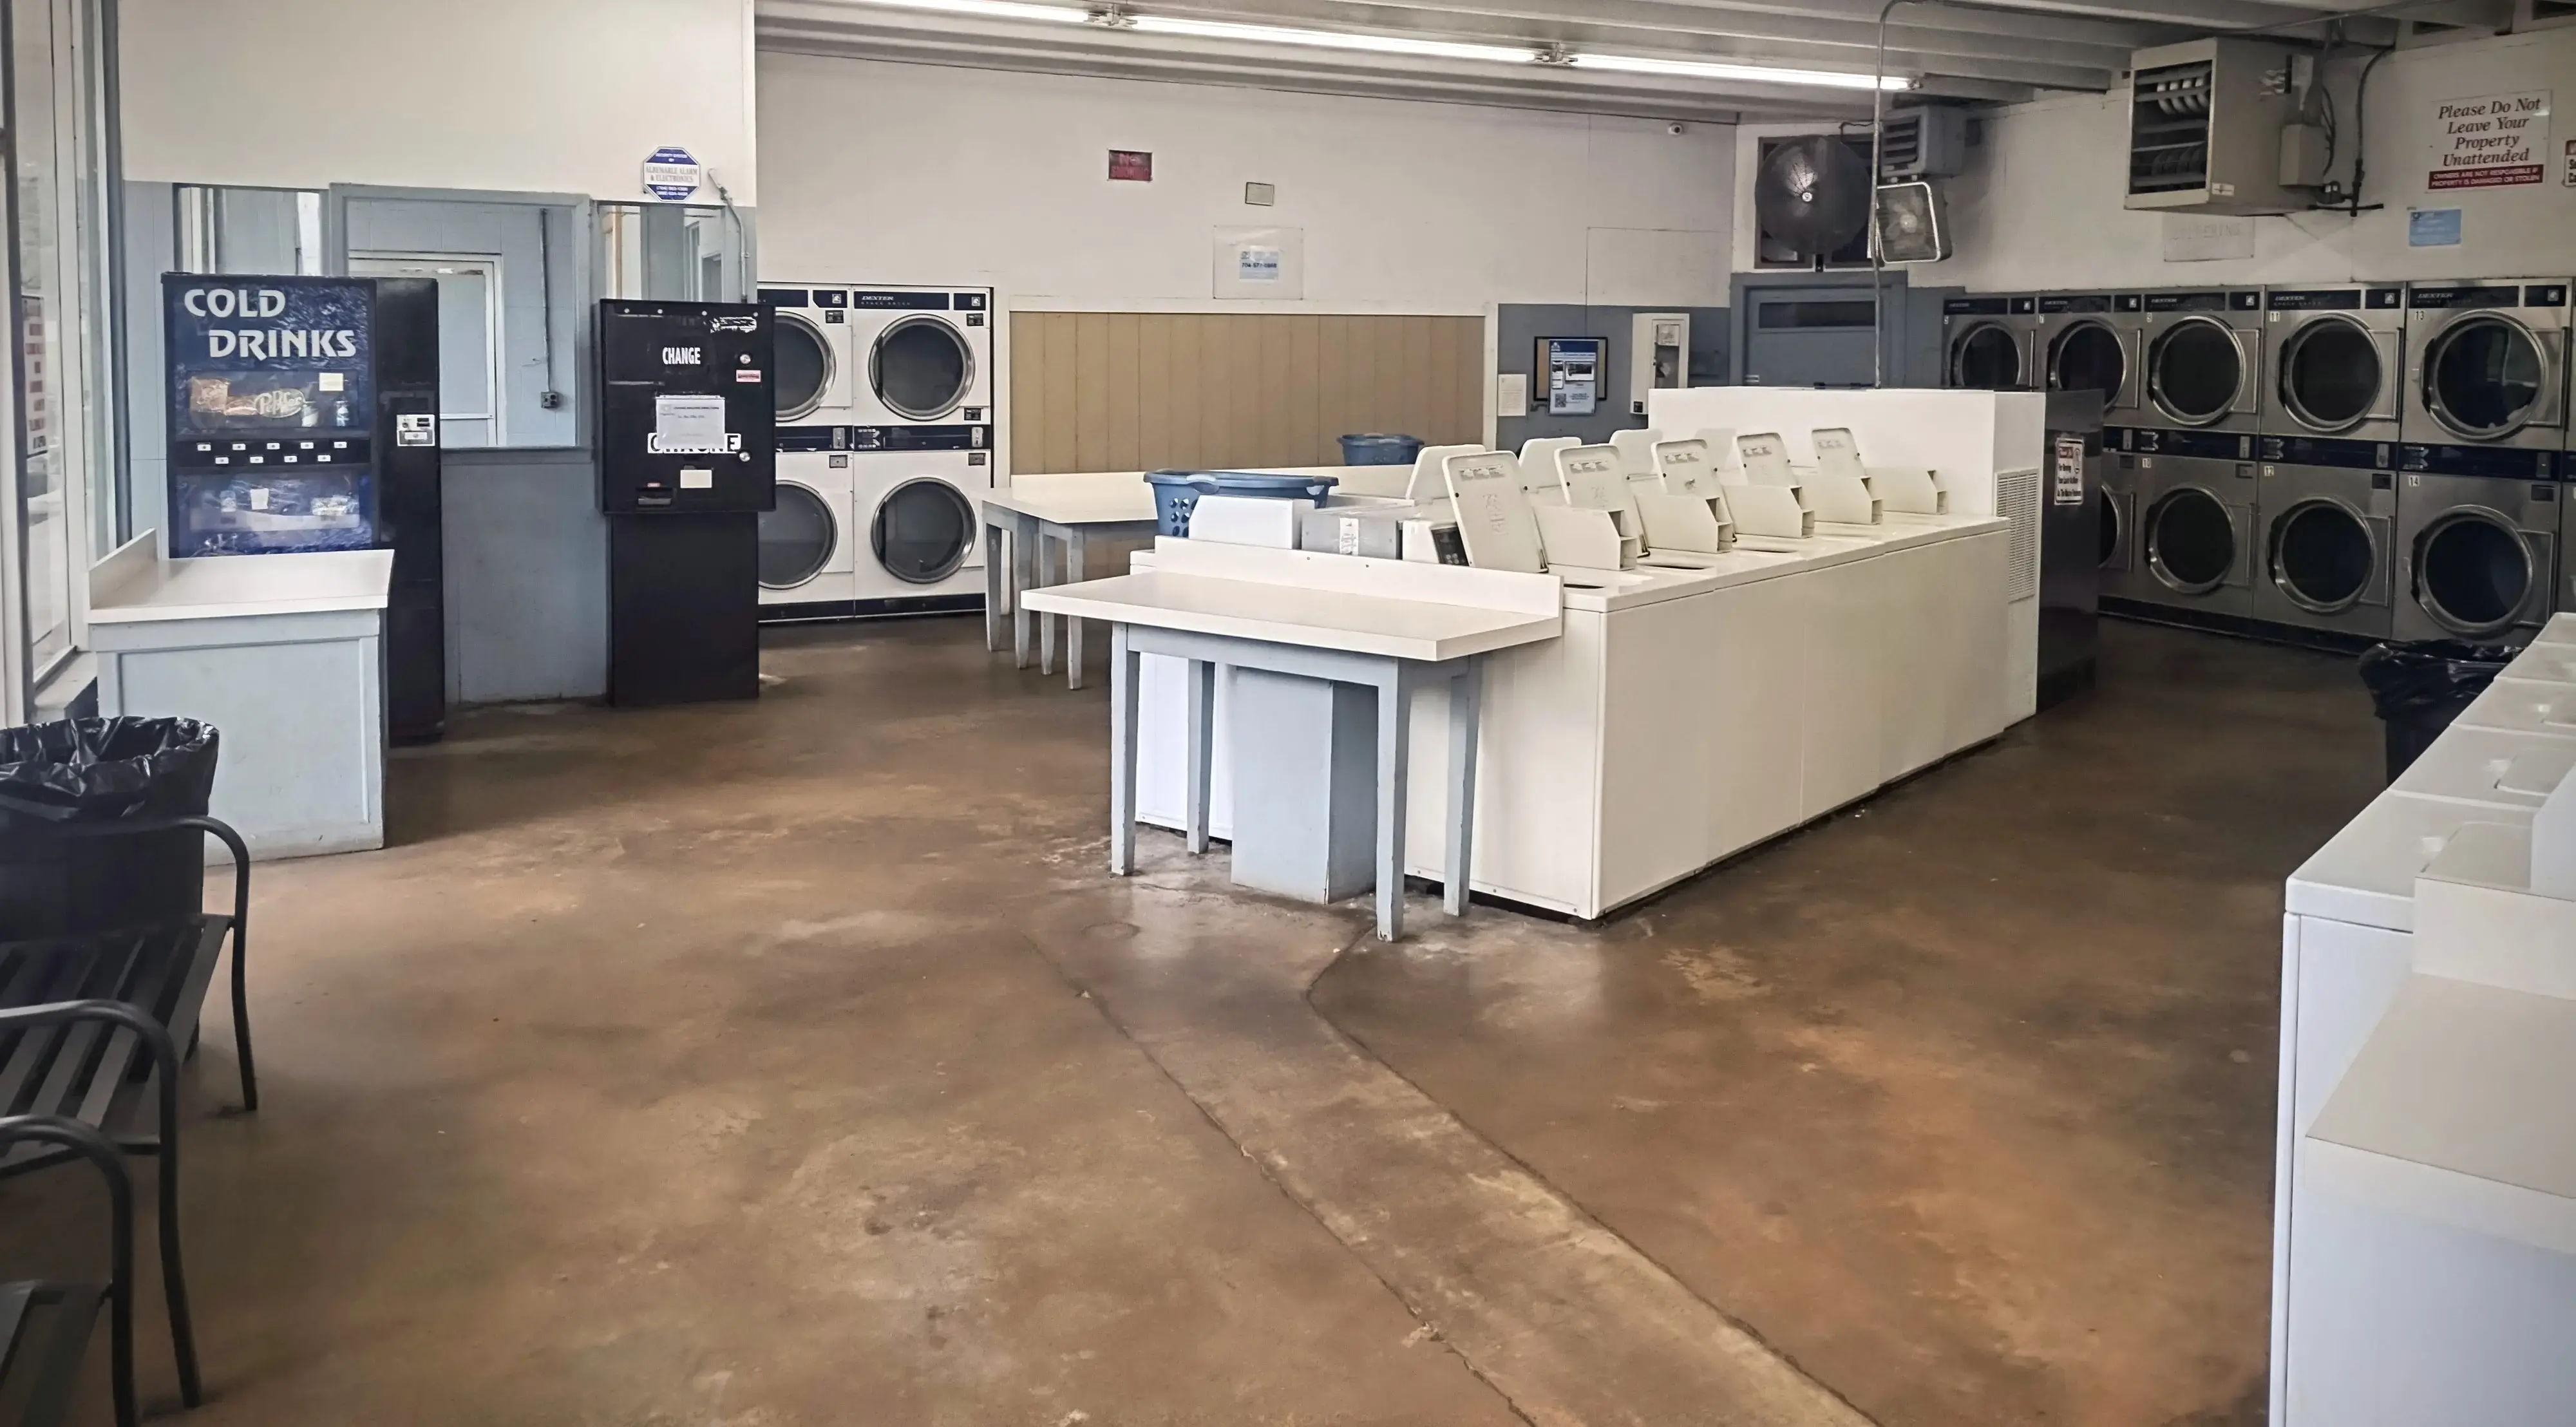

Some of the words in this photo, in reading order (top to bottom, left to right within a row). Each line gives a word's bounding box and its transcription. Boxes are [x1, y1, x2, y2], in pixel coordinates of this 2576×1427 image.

[2438, 105, 2486, 119] Please
[2490, 100, 2510, 114] Do
[2515, 98, 2541, 111] Not
[2447, 121, 2490, 134] Leave
[2496, 117, 2530, 129] Your
[2454, 135, 2520, 150] Property
[2443, 147, 2530, 166] Unattended
[185, 288, 286, 318] COLD
[2271, 312, 2278, 321] 11
[2416, 311, 2425, 321] 13
[209, 329, 356, 361] DRINKS
[662, 347, 701, 365] CHANGE
[2264, 466, 2274, 476] 12
[2409, 475, 2419, 486] 14
